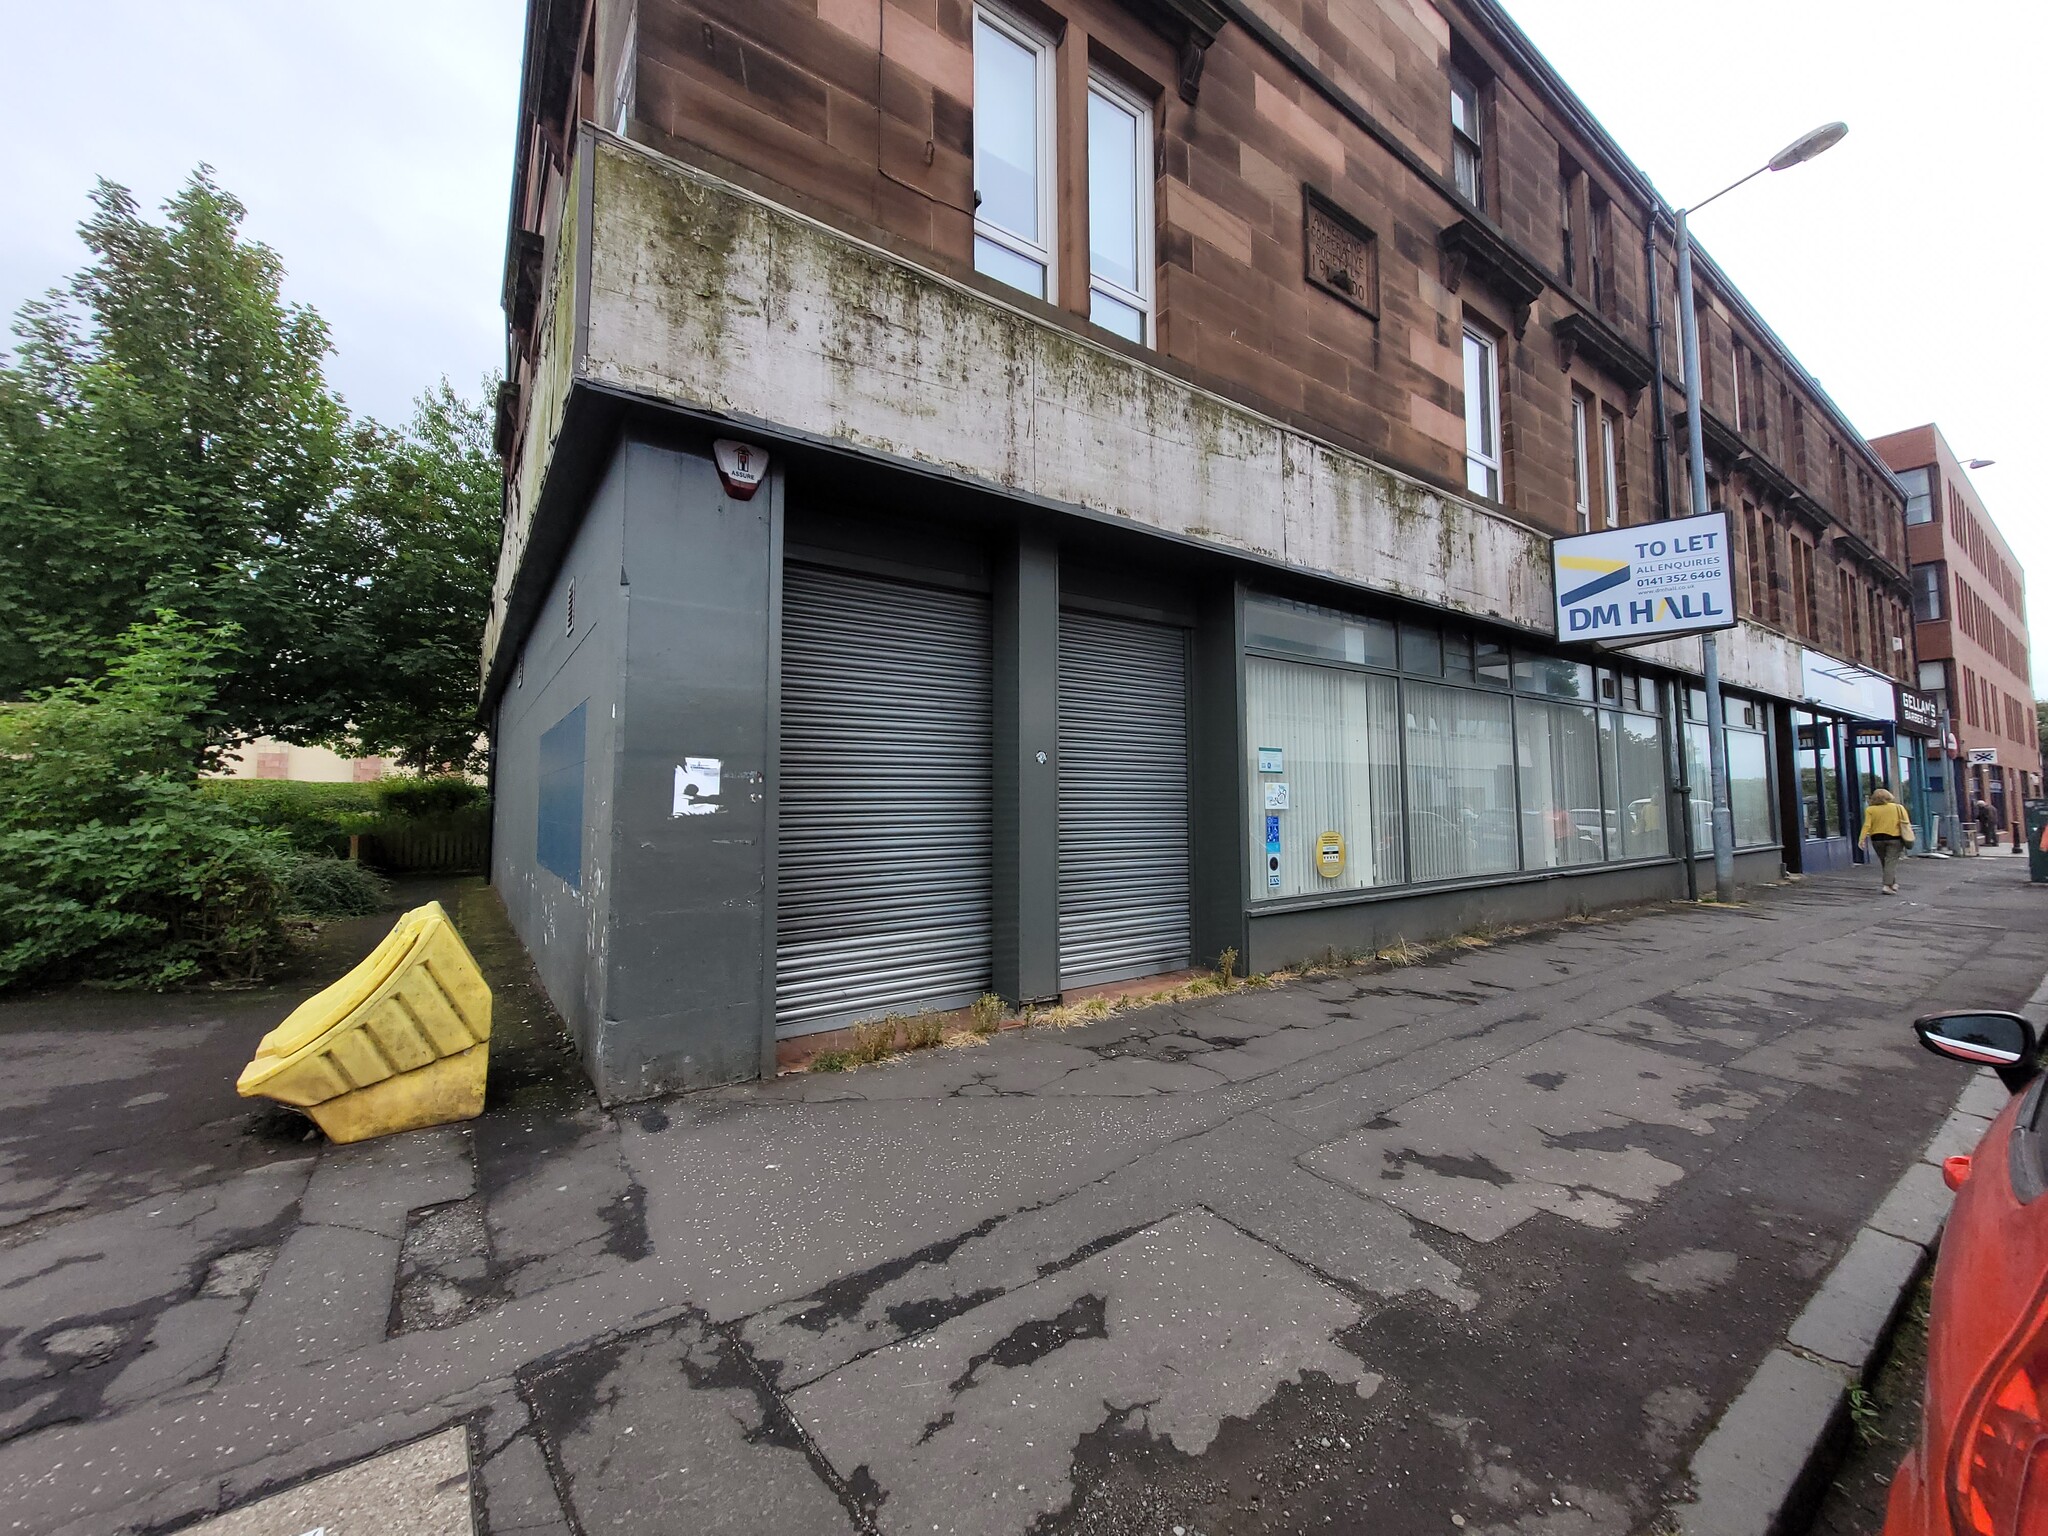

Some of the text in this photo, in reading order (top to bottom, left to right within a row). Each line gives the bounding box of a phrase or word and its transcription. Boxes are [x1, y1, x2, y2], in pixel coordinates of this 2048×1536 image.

[1311, 226, 1364, 270] COOPERATIVE
[732, 470, 754, 480] ASSURE
[1635, 532, 1718, 558] TO LET
[1636, 557, 1720, 574] ALL ENQUIRIES
[1637, 570, 1722, 587] 0141 352 6406
[1638, 584, 1695, 596] www.dmhall.co.uk
[1570, 592, 1724, 632] DM HALL
[1856, 735, 1886, 744] HILL
